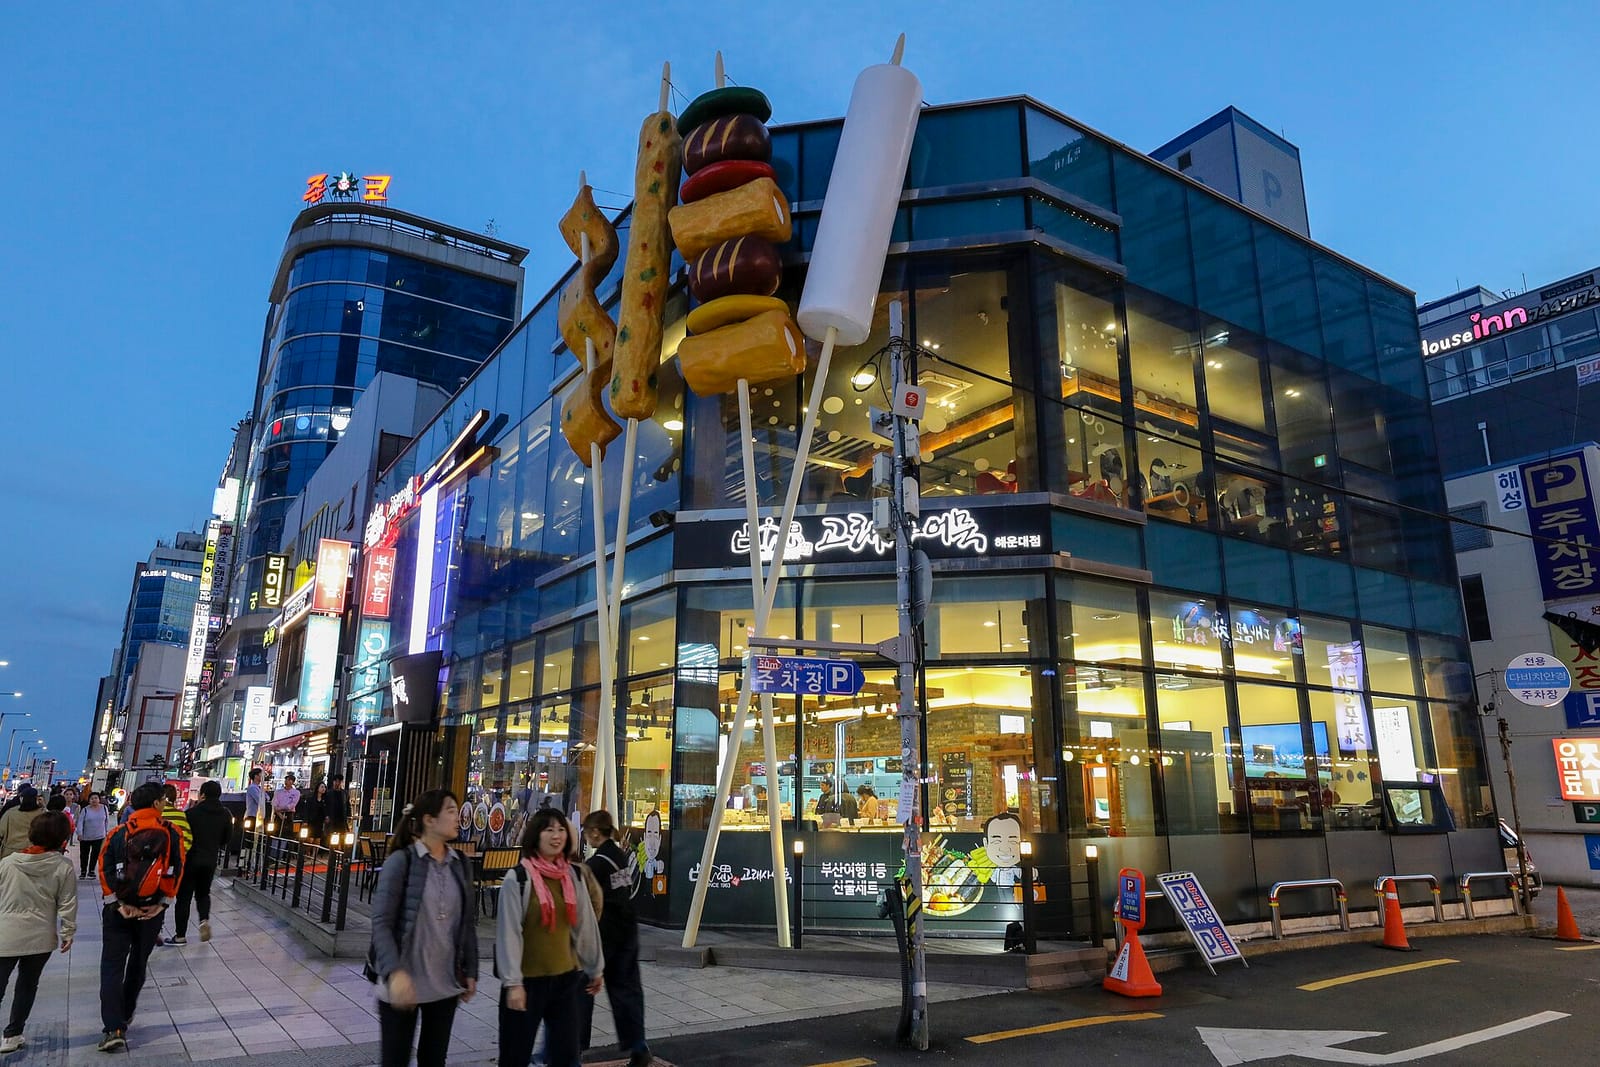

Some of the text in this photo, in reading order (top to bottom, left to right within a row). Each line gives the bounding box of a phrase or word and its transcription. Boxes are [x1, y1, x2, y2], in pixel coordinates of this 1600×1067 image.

[1470, 306, 1528, 340] inn
[1498, 470, 1523, 510] 해성
[1531, 463, 1577, 504] P
[1538, 507, 1597, 590] 주차장
[264, 557, 285, 605] 타이킹
[192, 617, 206, 657] 노래타운
[758, 659, 779, 669] 50m
[1524, 656, 1546, 666] 전용
[757, 670, 824, 692] 주차장
[832, 667, 848, 689] P
[1521, 689, 1558, 700] 주차장
[1559, 742, 1584, 796] 유료
[1583, 806, 1597, 821] P
[821, 862, 887, 879] 부산여행 1등
[1127, 880, 1134, 891] P
[1172, 886, 1189, 909] P
[1183, 908, 1216, 926] 주차장
[1199, 931, 1217, 956] P
